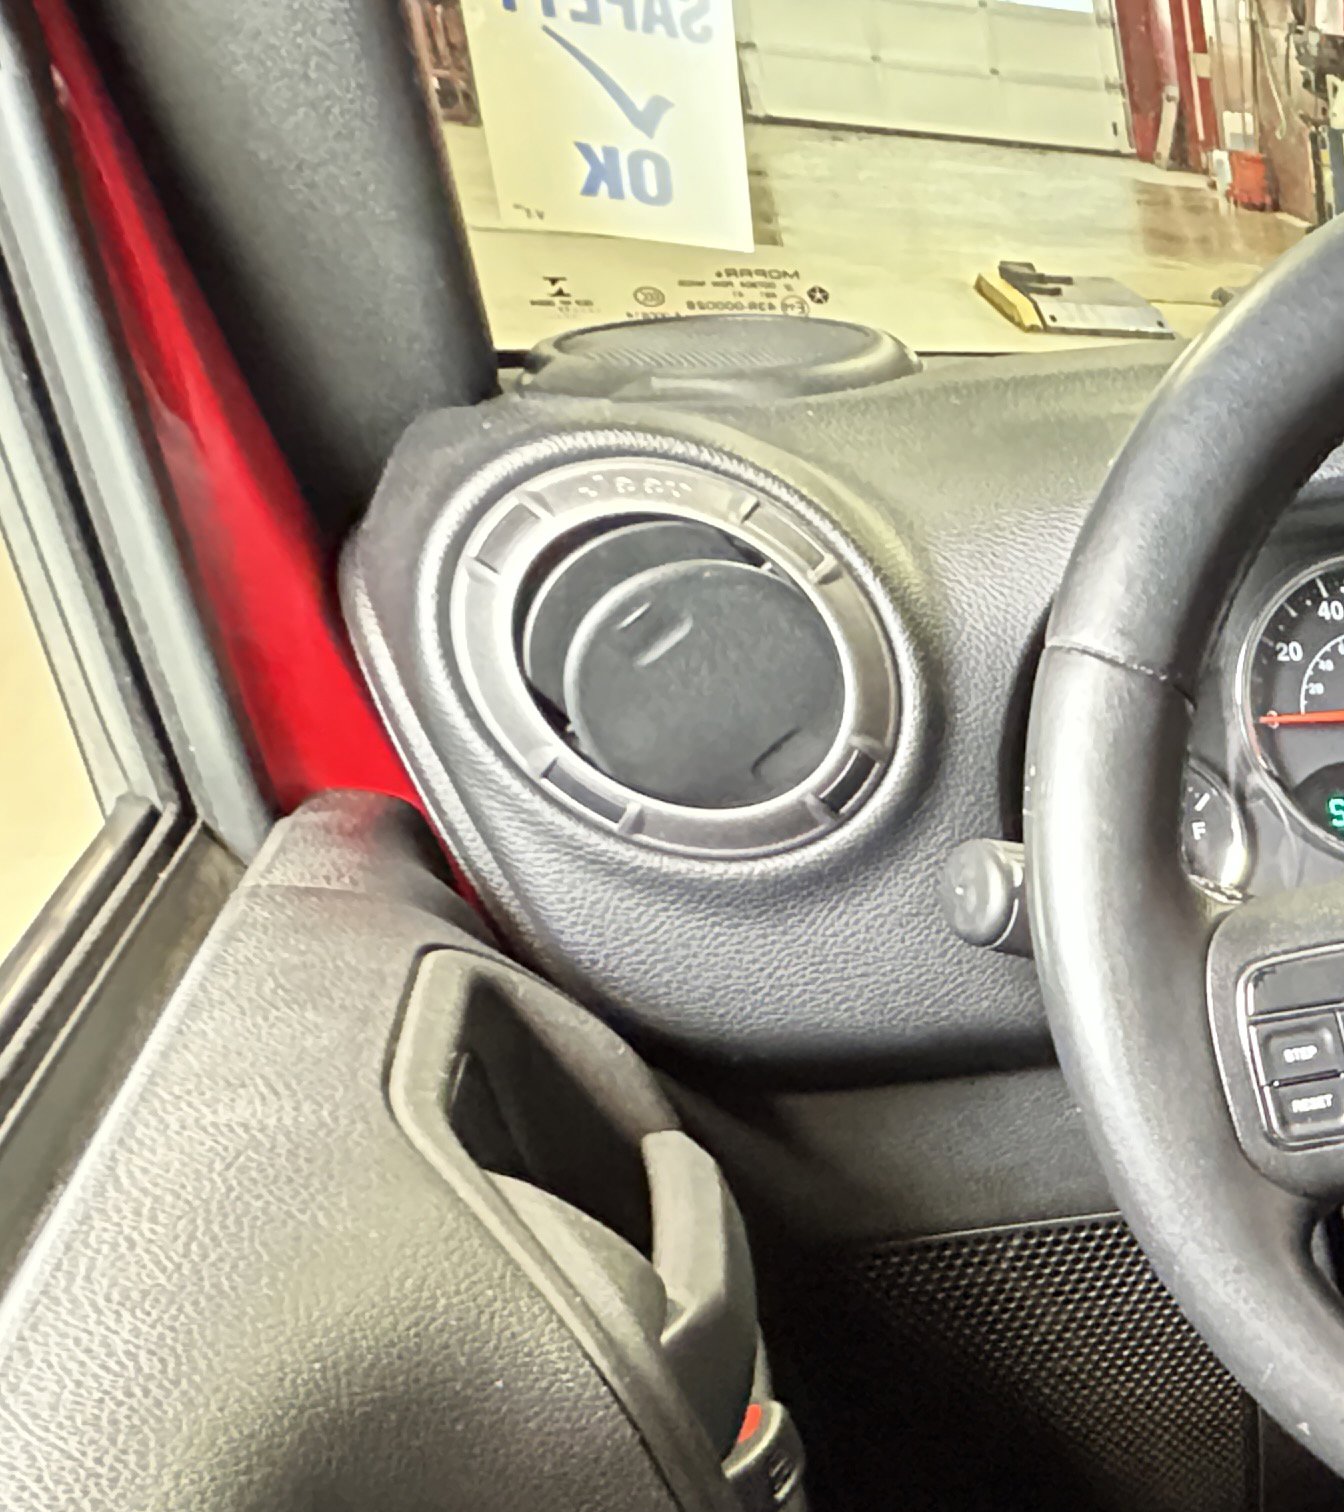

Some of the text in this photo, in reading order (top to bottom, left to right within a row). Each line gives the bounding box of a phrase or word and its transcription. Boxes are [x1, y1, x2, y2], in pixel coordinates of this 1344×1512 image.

[1317, 600, 1344, 621] 40
[1276, 641, 1303, 662] 20
[1308, 682, 1324, 694] 20
[1192, 821, 1206, 841] F
[1283, 1045, 1318, 1063] STEP
[1291, 1094, 1334, 1113] RESET
